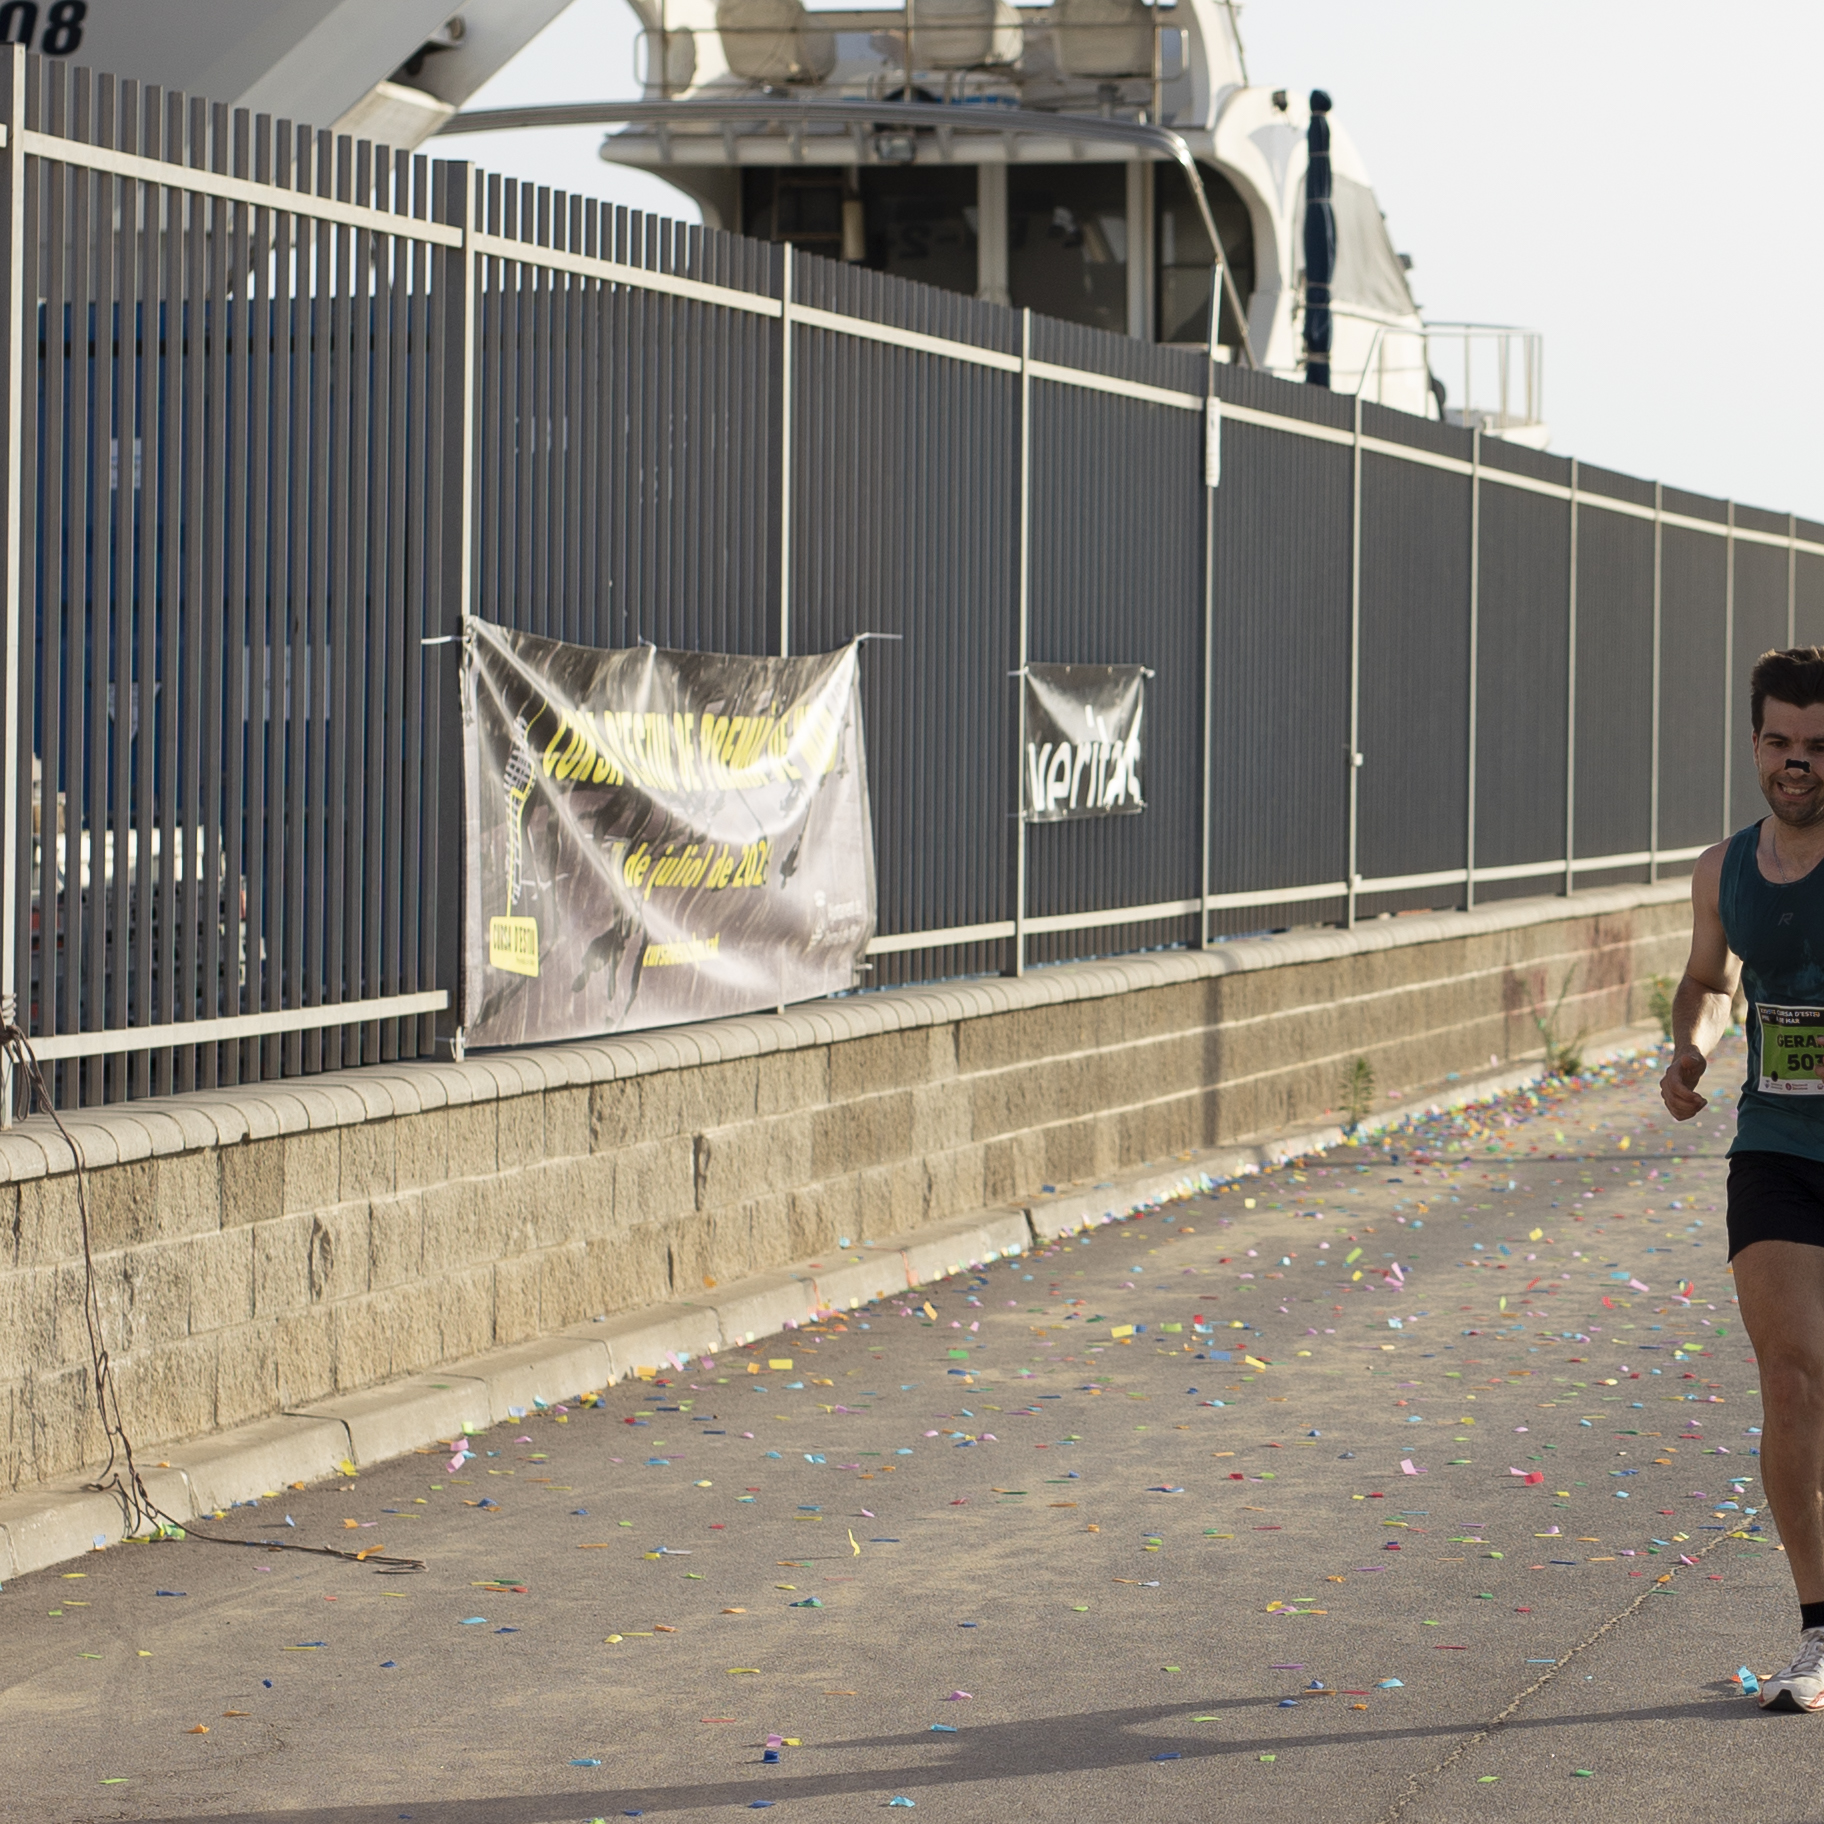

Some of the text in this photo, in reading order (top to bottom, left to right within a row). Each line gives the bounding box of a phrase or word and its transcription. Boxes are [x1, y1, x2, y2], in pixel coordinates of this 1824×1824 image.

[624, 841, 652, 888] de
[644, 844, 716, 902] juliol
[706, 843, 735, 889] de
